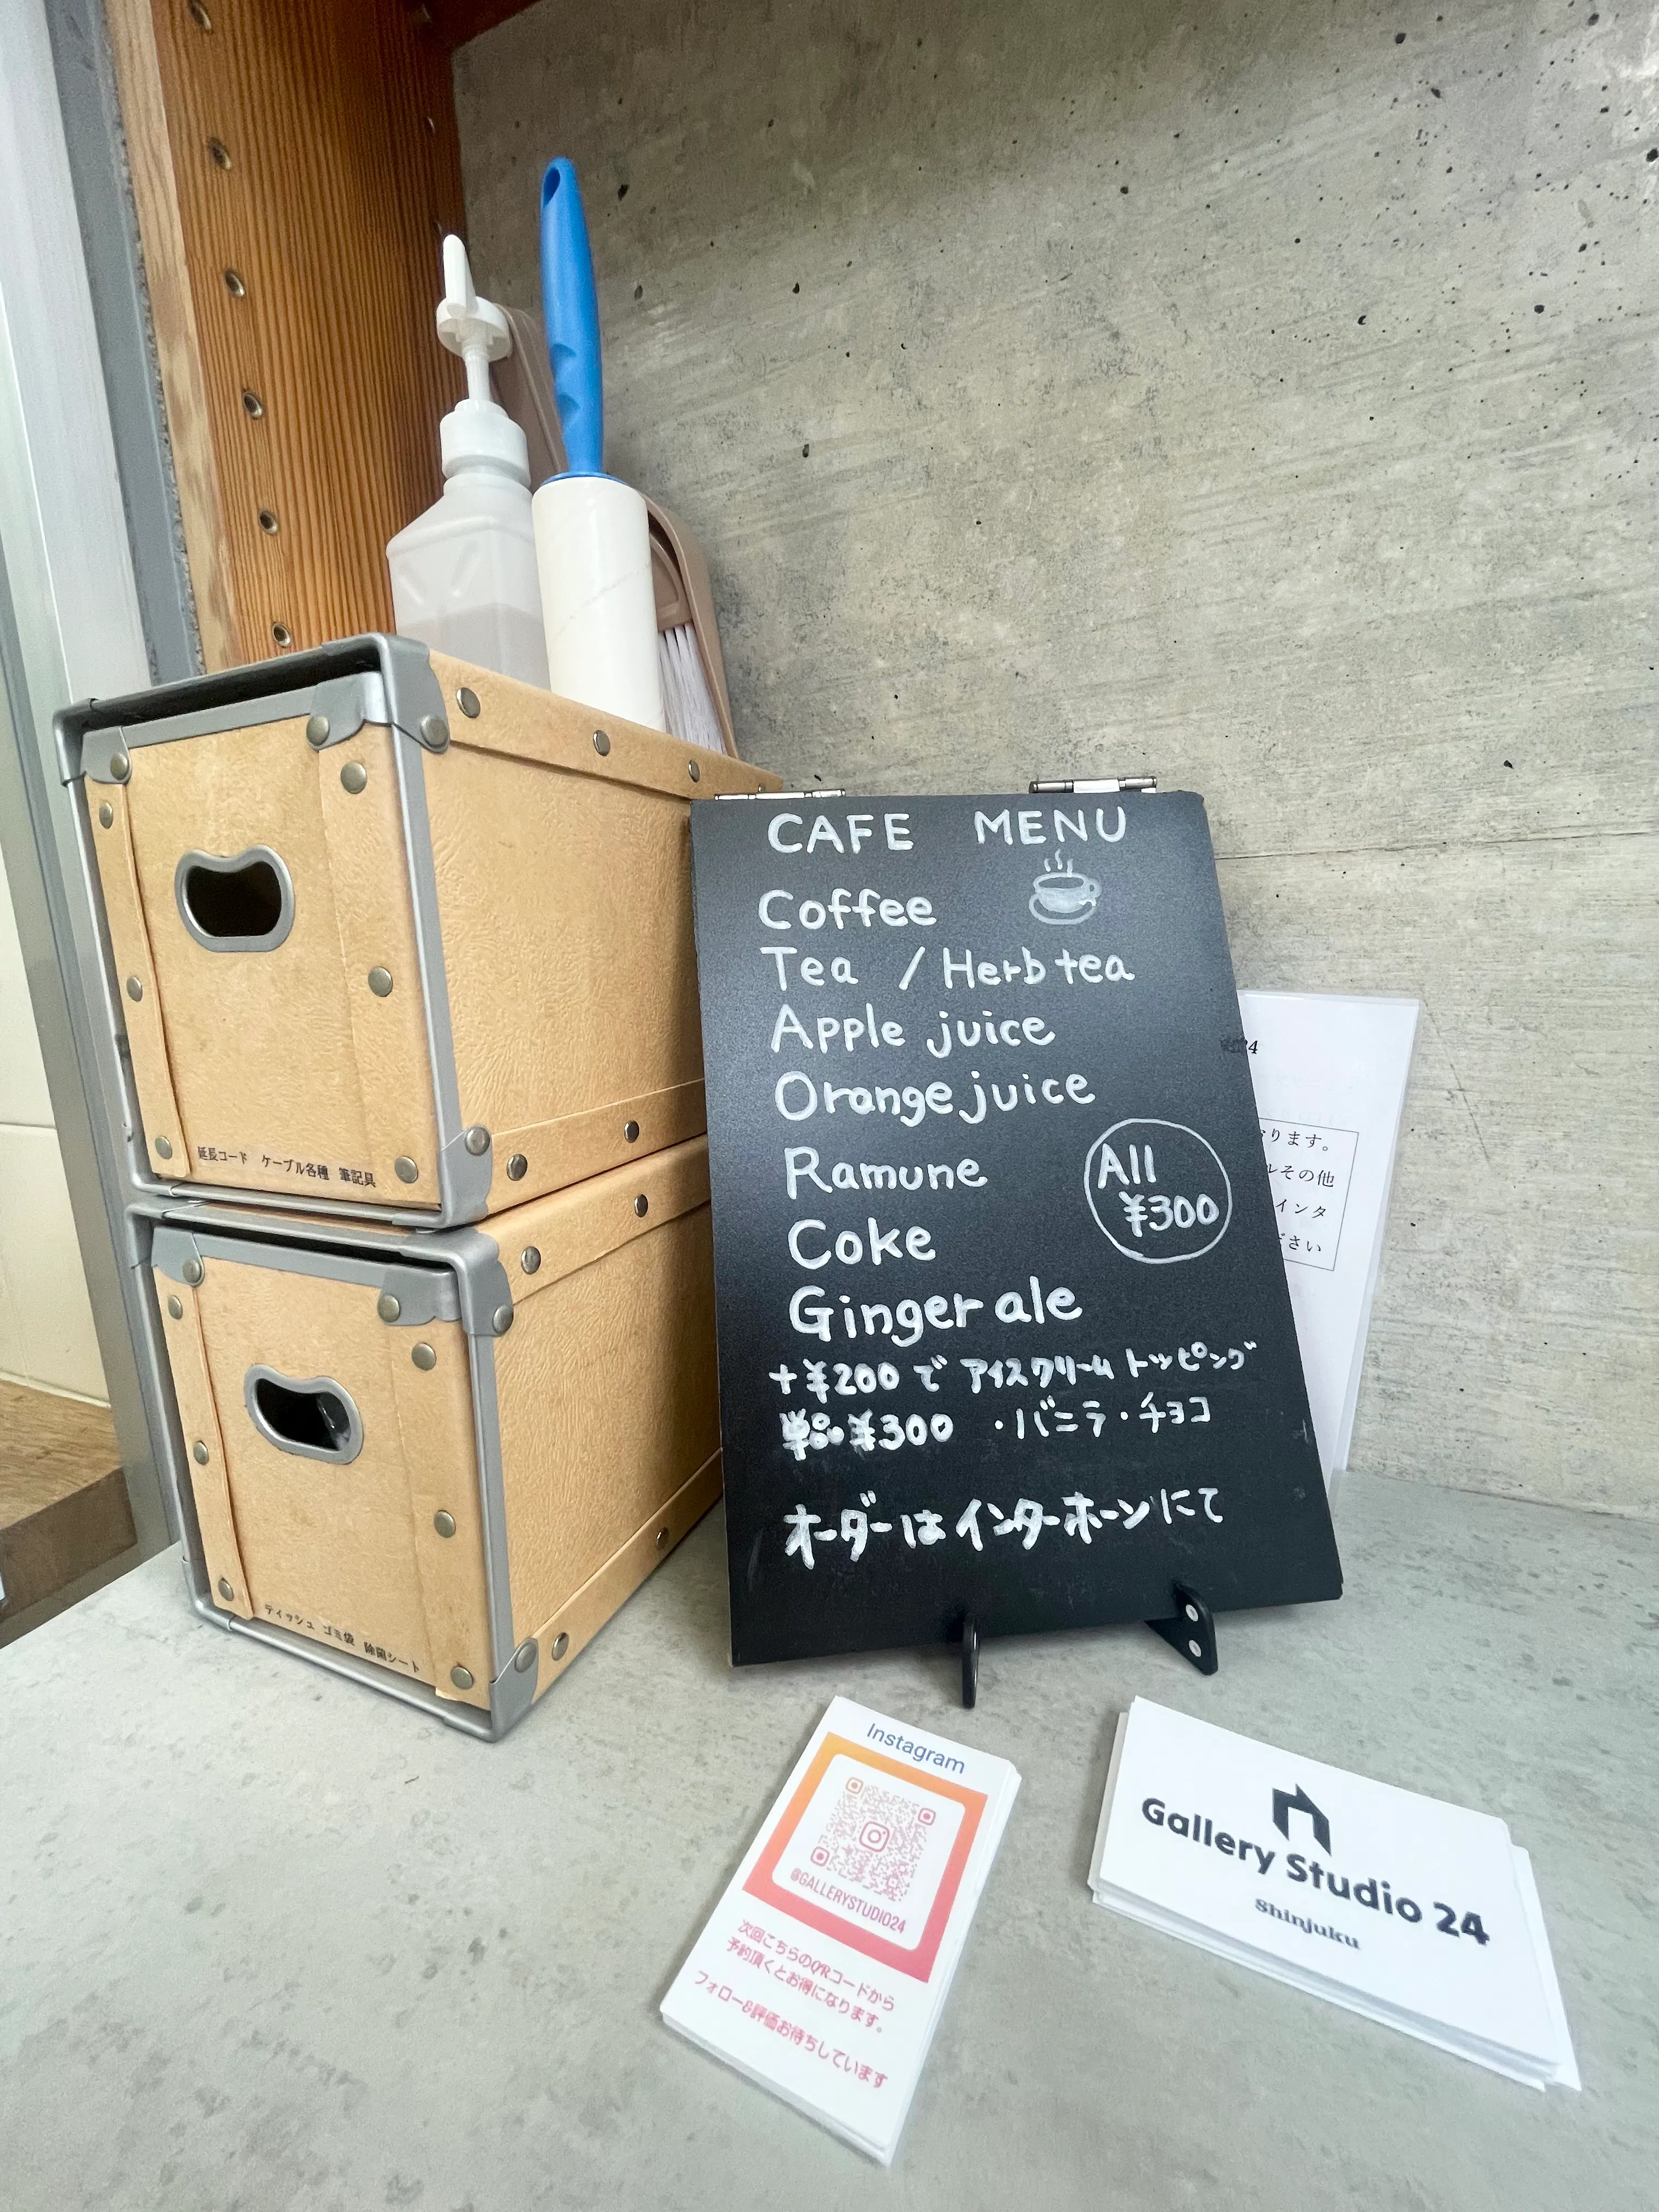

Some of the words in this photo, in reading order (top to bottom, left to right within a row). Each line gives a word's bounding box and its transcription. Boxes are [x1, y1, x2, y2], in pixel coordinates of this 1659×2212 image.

[768, 813, 914, 854] CAFE
[974, 806, 1126, 845] MENU
[758, 888, 937, 930] Coffee
[759, 946, 859, 991] Tea
[943, 946, 1046, 989] Herb
[1060, 950, 1135, 983] tea
[770, 1002, 906, 1054] Apple
[926, 1010, 1056, 1058] juice
[774, 1070, 953, 1127] Orange
[958, 1070, 1096, 1124] juice
[1261, 1127, 1328, 1152] ります。
[198, 1146, 247, 1165] 延長コード
[338, 1167, 376, 1188] 筆記具
[784, 1146, 988, 1200] Ramune
[1098, 1143, 1156, 1189] All
[1118, 1191, 1219, 1238] ¥300
[1276, 1199, 1327, 1218] インタ
[788, 1217, 936, 1270] Coke
[1279, 1233, 1321, 1252] さい
[789, 1285, 984, 1347] Ginger
[995, 1276, 1083, 1324] ale
[264, 1604, 315, 1630] ティッシュ
[867, 1723, 965, 1774] Instagram
[1142, 1797, 1276, 1875] Gallery
[1285, 1853, 1423, 1924] Studio
[1434, 1902, 1490, 1945] 24
[791, 1867, 906, 1934] @GALLERYSTUDIO24
[1255, 1898, 1361, 1950] Shinjuku
[726, 1937, 882, 2033] 予約頂くとお得になります。
[737, 1919, 894, 2012] 次回こちらのQRコードから
